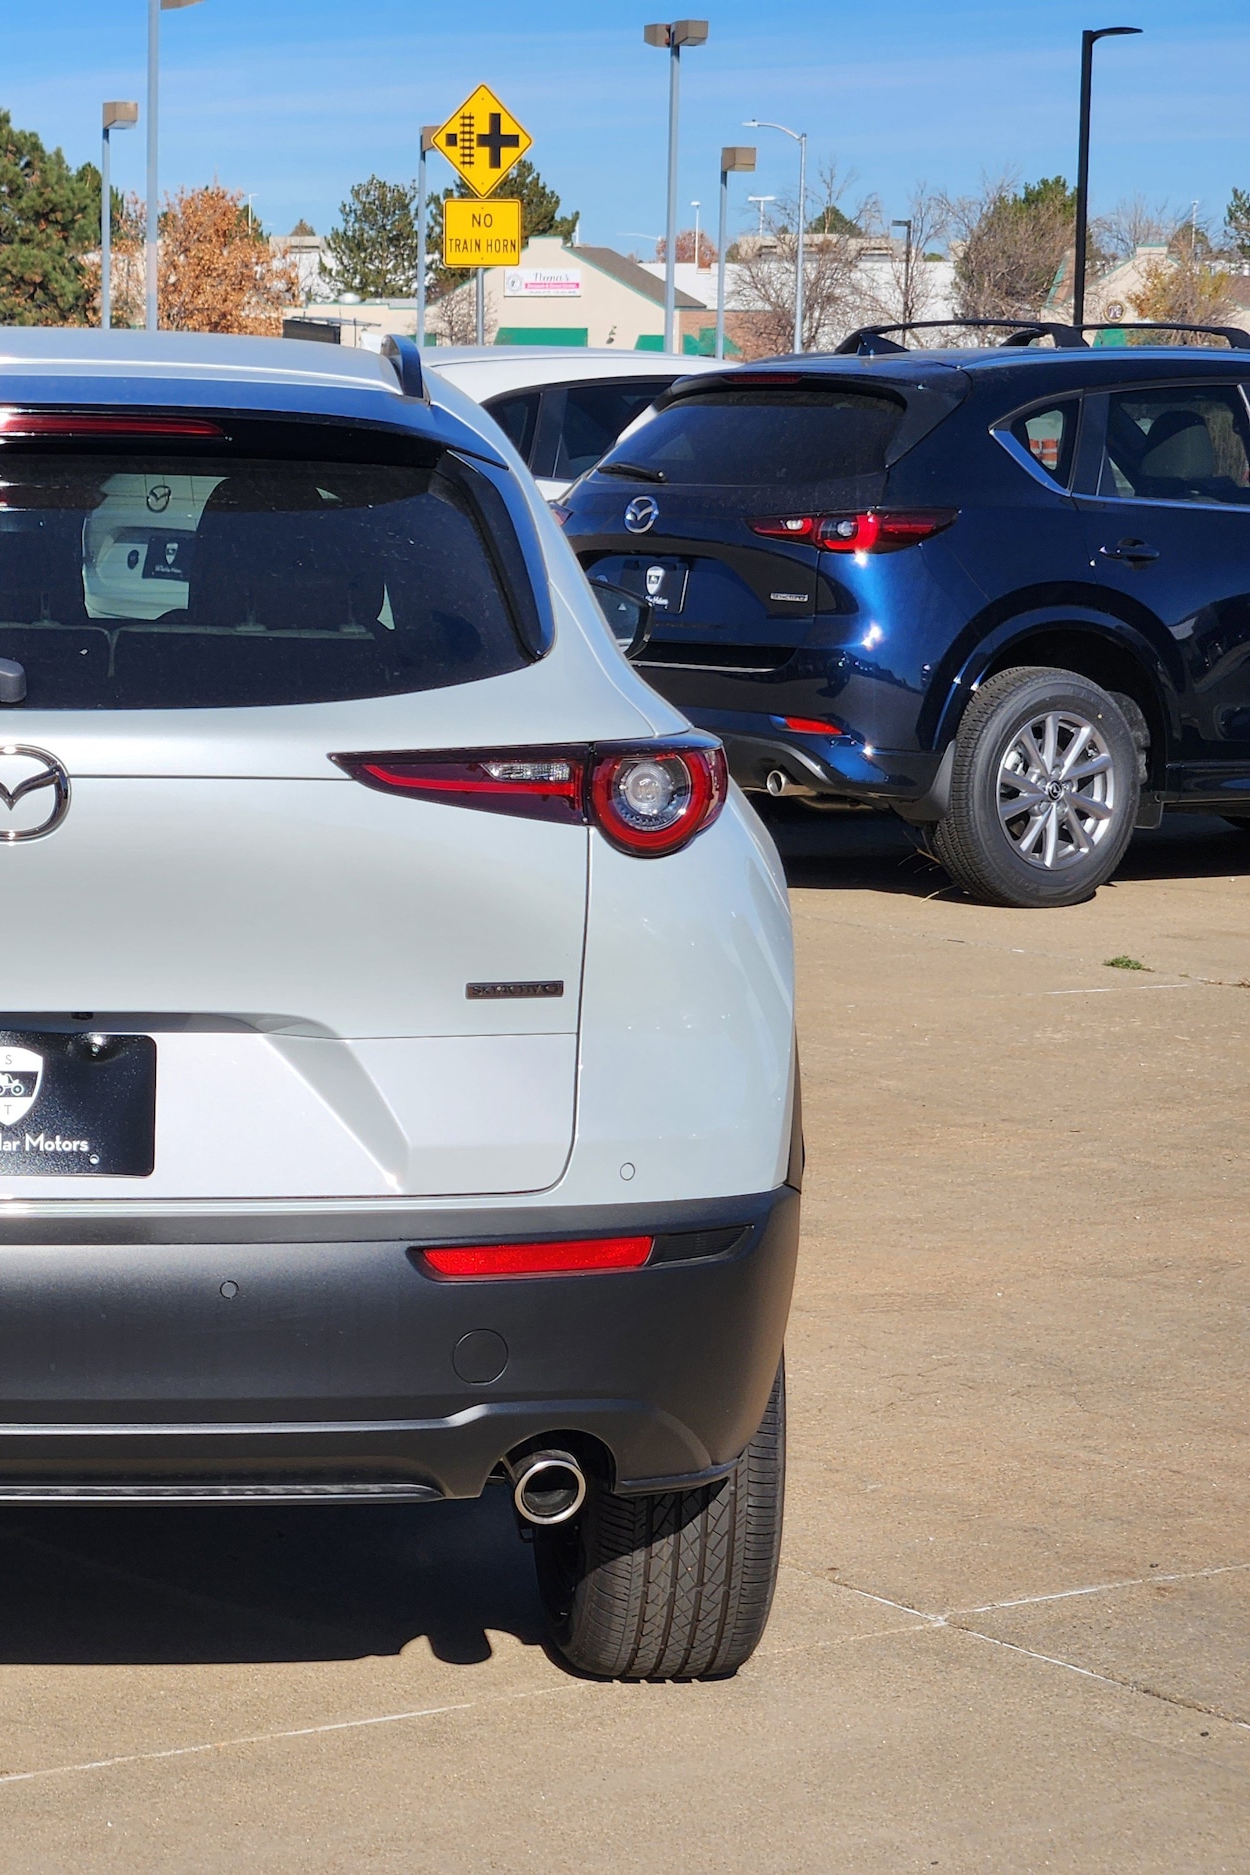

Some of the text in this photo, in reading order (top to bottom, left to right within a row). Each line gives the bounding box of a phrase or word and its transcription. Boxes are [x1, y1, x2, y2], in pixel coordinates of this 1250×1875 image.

[471, 213, 493, 228] NO
[448, 238, 517, 253] TRAIN HORN
[4, 1054, 13, 1066] S
[4, 1104, 12, 1115] T
[25, 1133, 90, 1151] Motors
